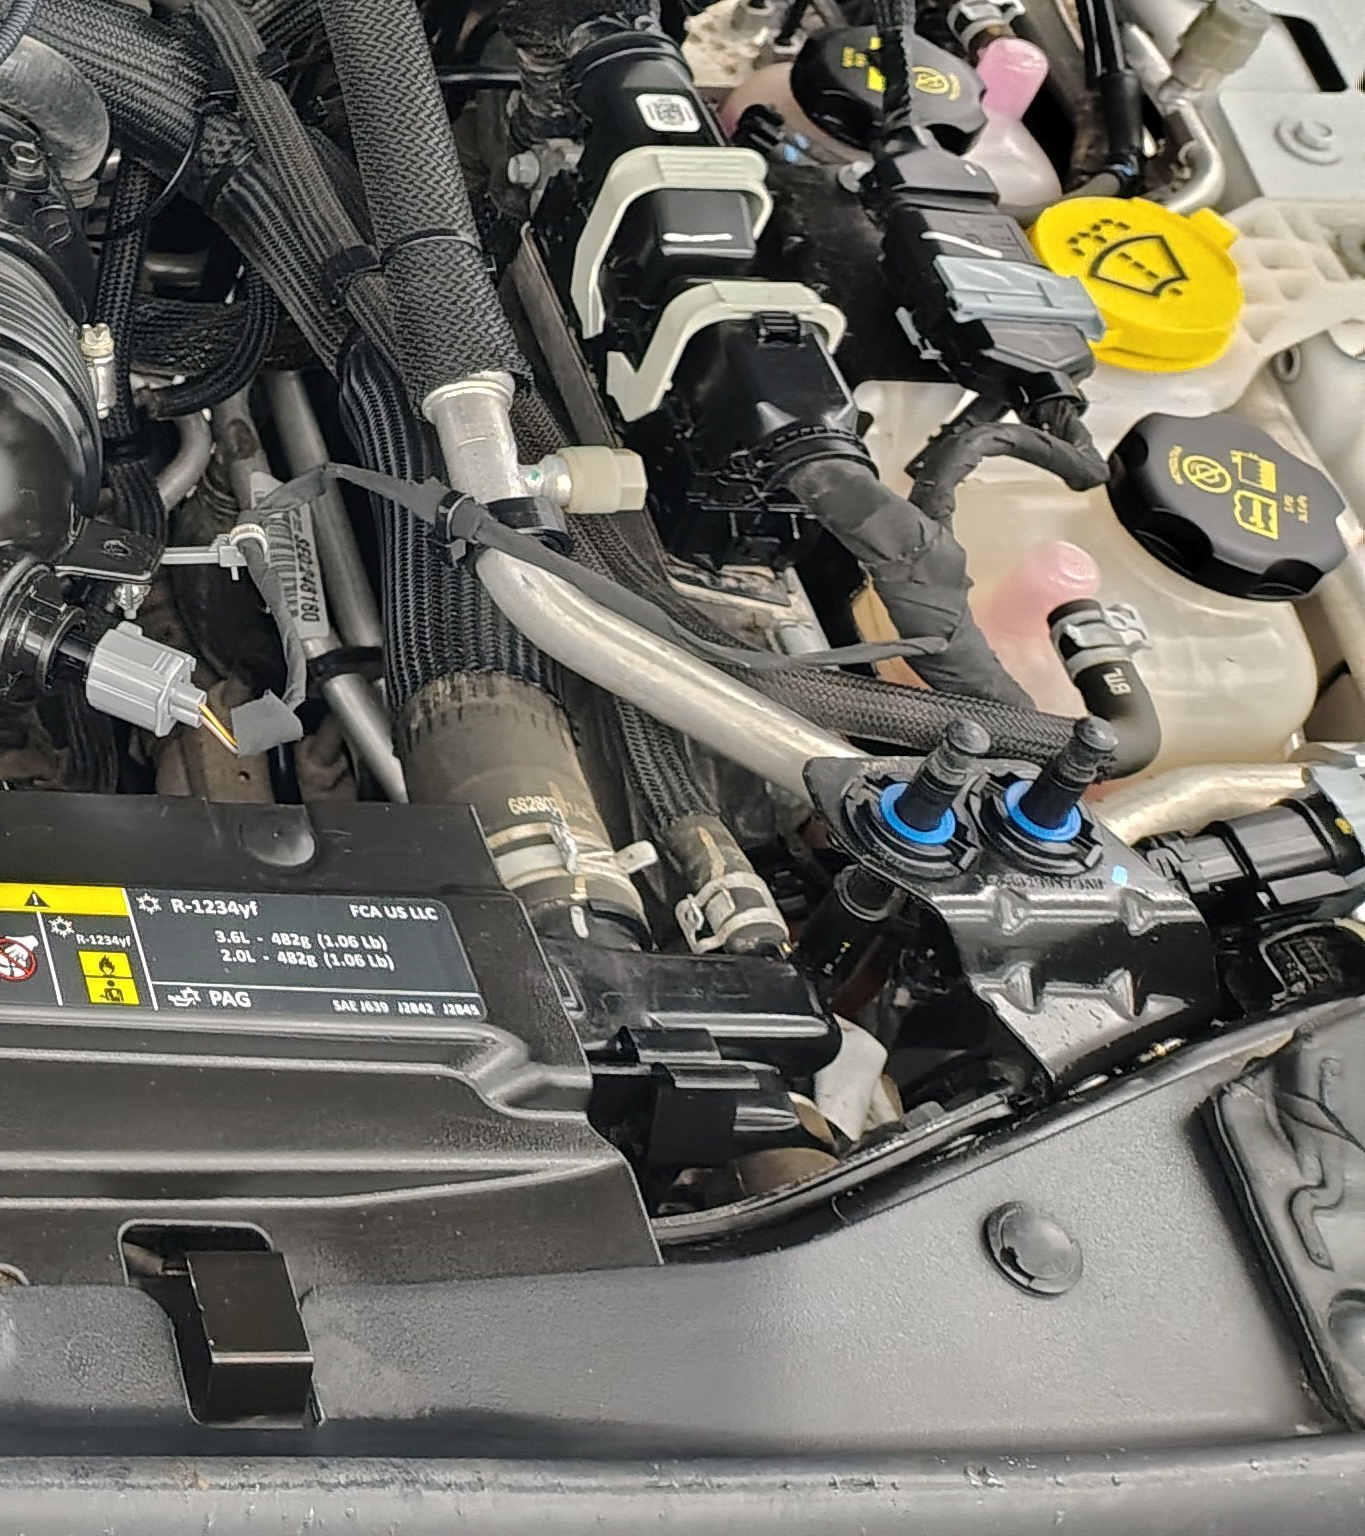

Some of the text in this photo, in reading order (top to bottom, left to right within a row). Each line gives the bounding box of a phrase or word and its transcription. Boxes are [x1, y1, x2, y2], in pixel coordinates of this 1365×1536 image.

[170, 898, 258, 919] R-1234yf
[349, 904, 439, 921] FCA US LLC
[214, 930, 250, 944] 3.6L
[271, 932, 312, 949] 482g
[317, 933, 359, 950] (1.06
[220, 949, 256, 963] 2.0L
[277, 951, 318, 968] 482g
[323, 952, 366, 970] (1.06
[208, 990, 252, 1008] PAG
[332, 999, 357, 1012] SAE
